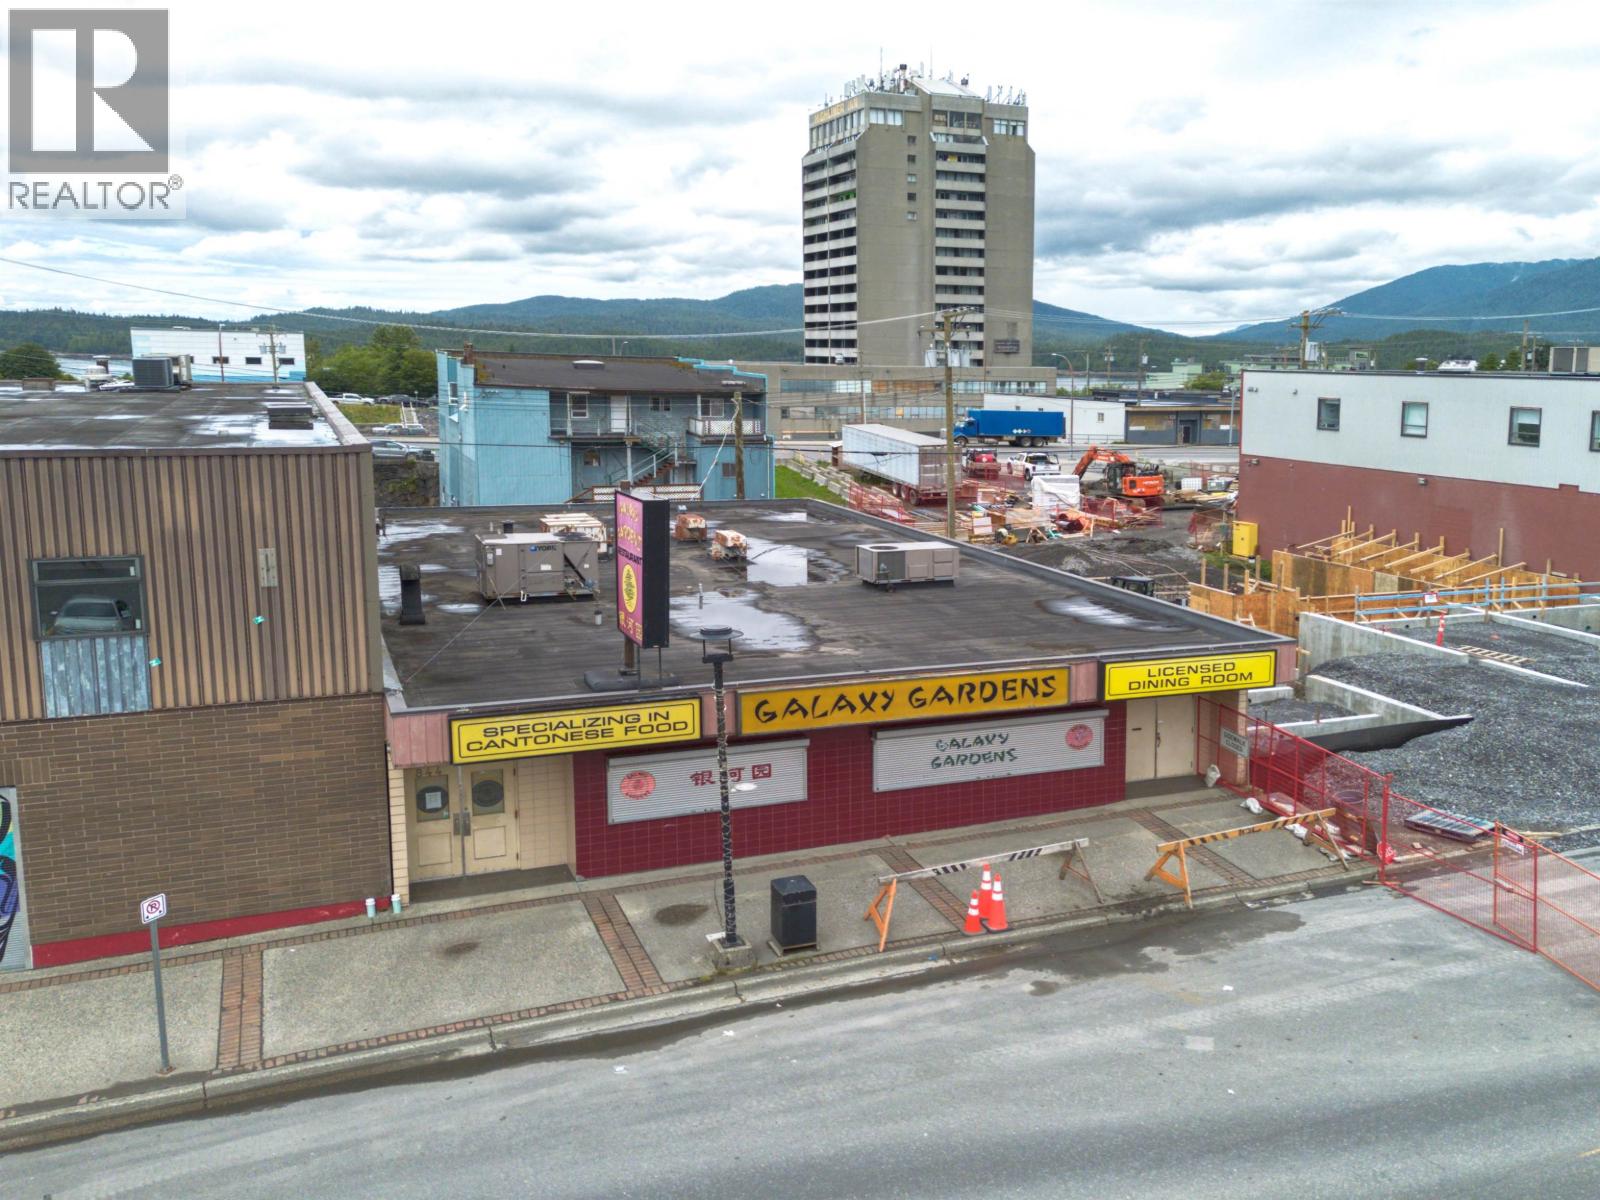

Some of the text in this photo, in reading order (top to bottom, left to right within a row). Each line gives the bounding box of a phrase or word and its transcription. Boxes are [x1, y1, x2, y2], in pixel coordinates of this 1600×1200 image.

[1147, 662, 1236, 678] LICENSED
[1128, 672, 1253, 691] DINING ROOM
[754, 675, 1056, 724] GALAXY GARDENS
[483, 711, 670, 738] SPECIALIZING IN
[466, 720, 688, 752] CANTONESE FOOD
[935, 733, 1009, 751] GALAXY
[931, 748, 1018, 769] GARDENS
